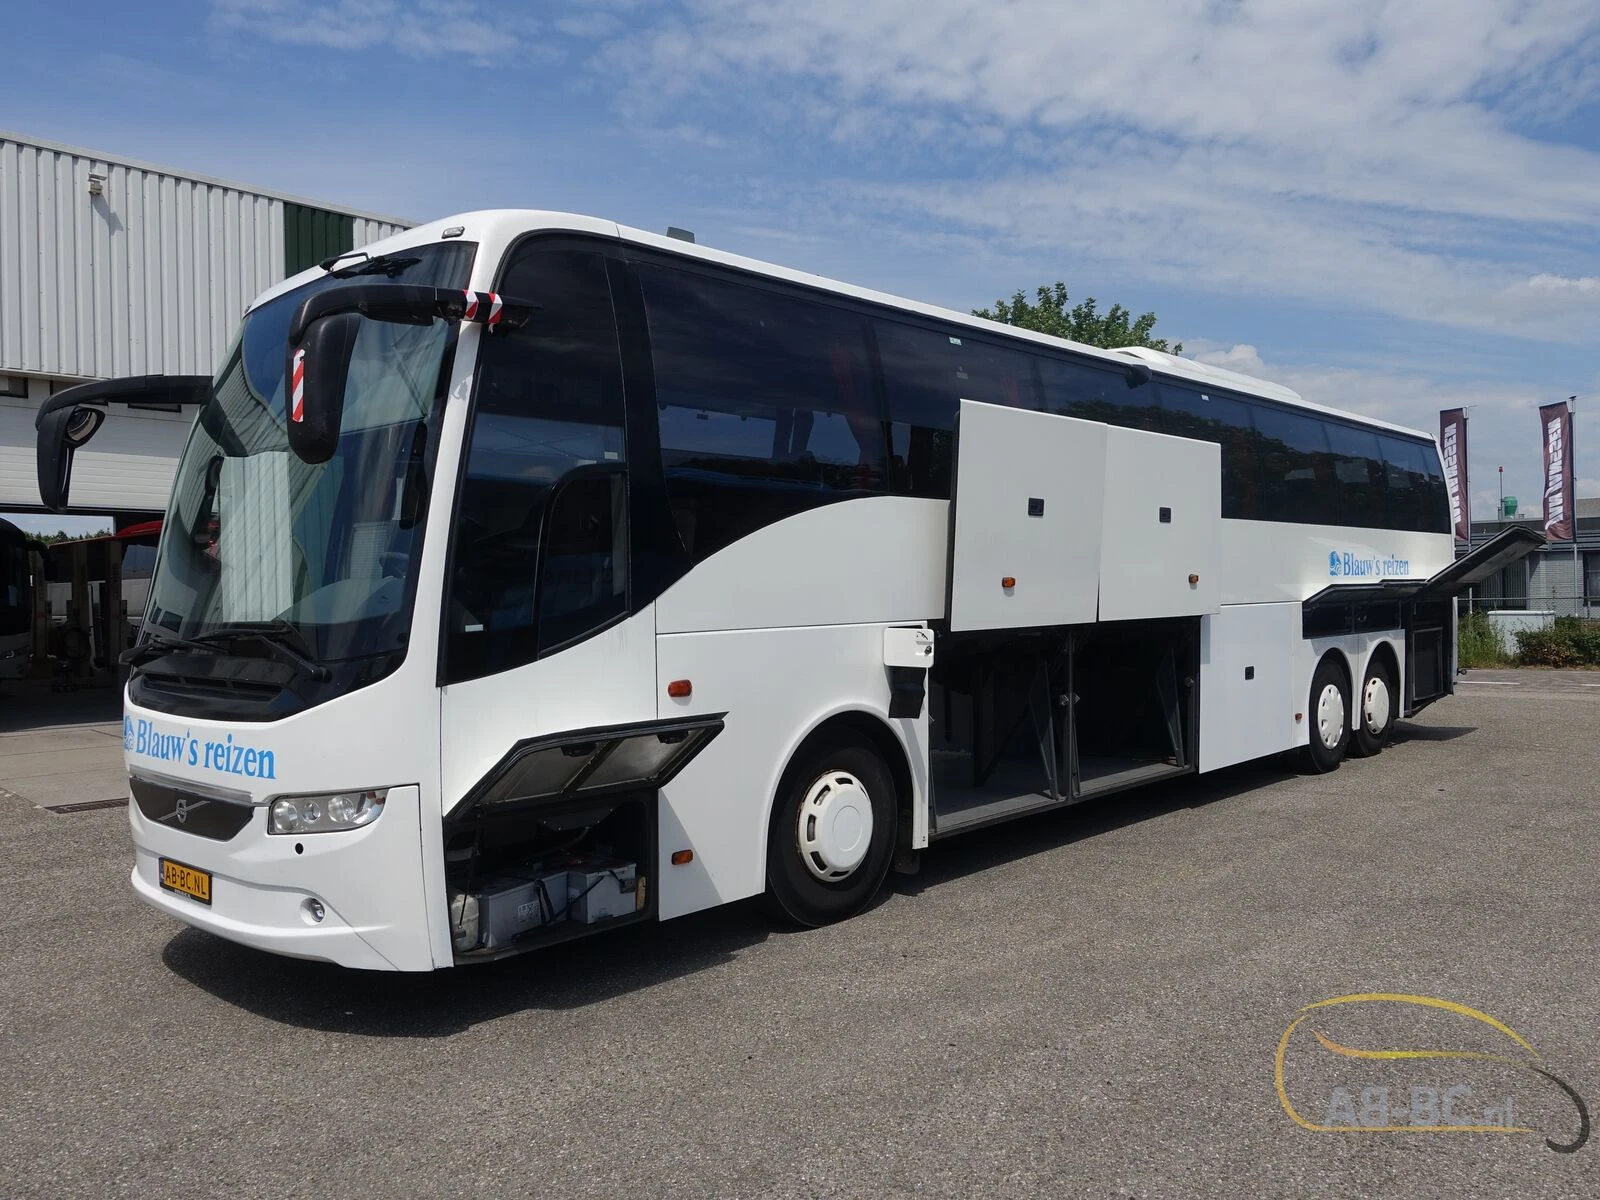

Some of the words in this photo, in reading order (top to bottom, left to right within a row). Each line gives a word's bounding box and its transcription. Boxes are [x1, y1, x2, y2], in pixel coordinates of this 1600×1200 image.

[1343, 552, 1380, 576] Blauw's
[1383, 553, 1409, 576] reizen
[136, 719, 198, 767] Blauw's
[203, 733, 277, 780] reizen
